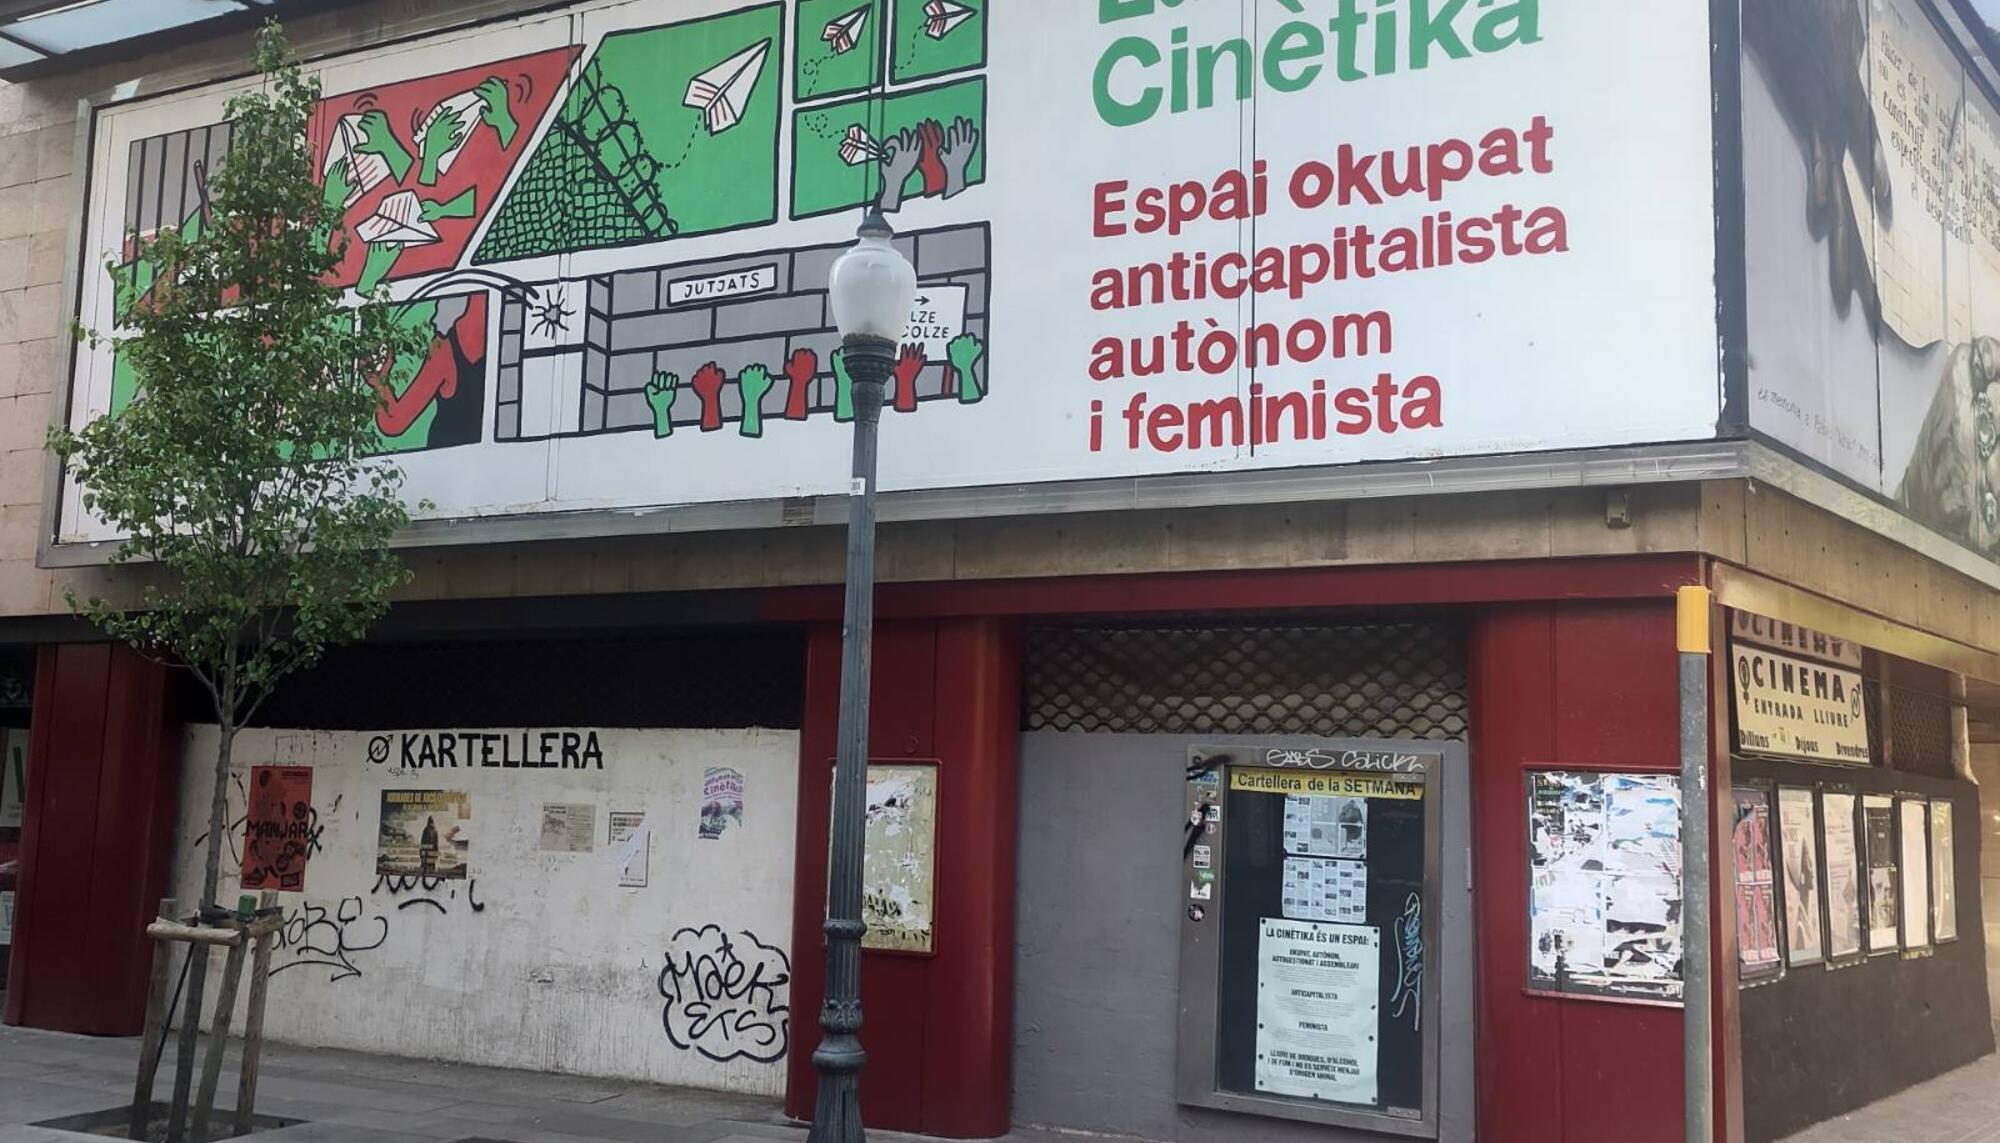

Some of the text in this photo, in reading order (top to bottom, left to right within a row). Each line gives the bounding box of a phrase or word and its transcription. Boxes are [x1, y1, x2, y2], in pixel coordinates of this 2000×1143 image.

[1093, 0, 1543, 127] Cinètika
[1093, 115, 1554, 237] Espai okupat
[1090, 206, 1570, 310] anticapitalista
[684, 272, 760, 298] JUTJATS
[1089, 310, 1393, 381] autònom
[1089, 373, 1444, 453] i feminista
[1753, 656, 1846, 703] CINEMA
[1754, 698, 1803, 720] ENTRADA
[400, 731, 604, 769] KARTELLERA
[1795, 736, 1819, 754] Dijous
[1238, 772, 1301, 790] Cartellera
[1307, 777, 1325, 791] de
[1328, 778, 1340, 791] la
[1343, 779, 1416, 796] SETMANA
[1265, 928, 1275, 937] LA
[1329, 933, 1340, 944] UN
